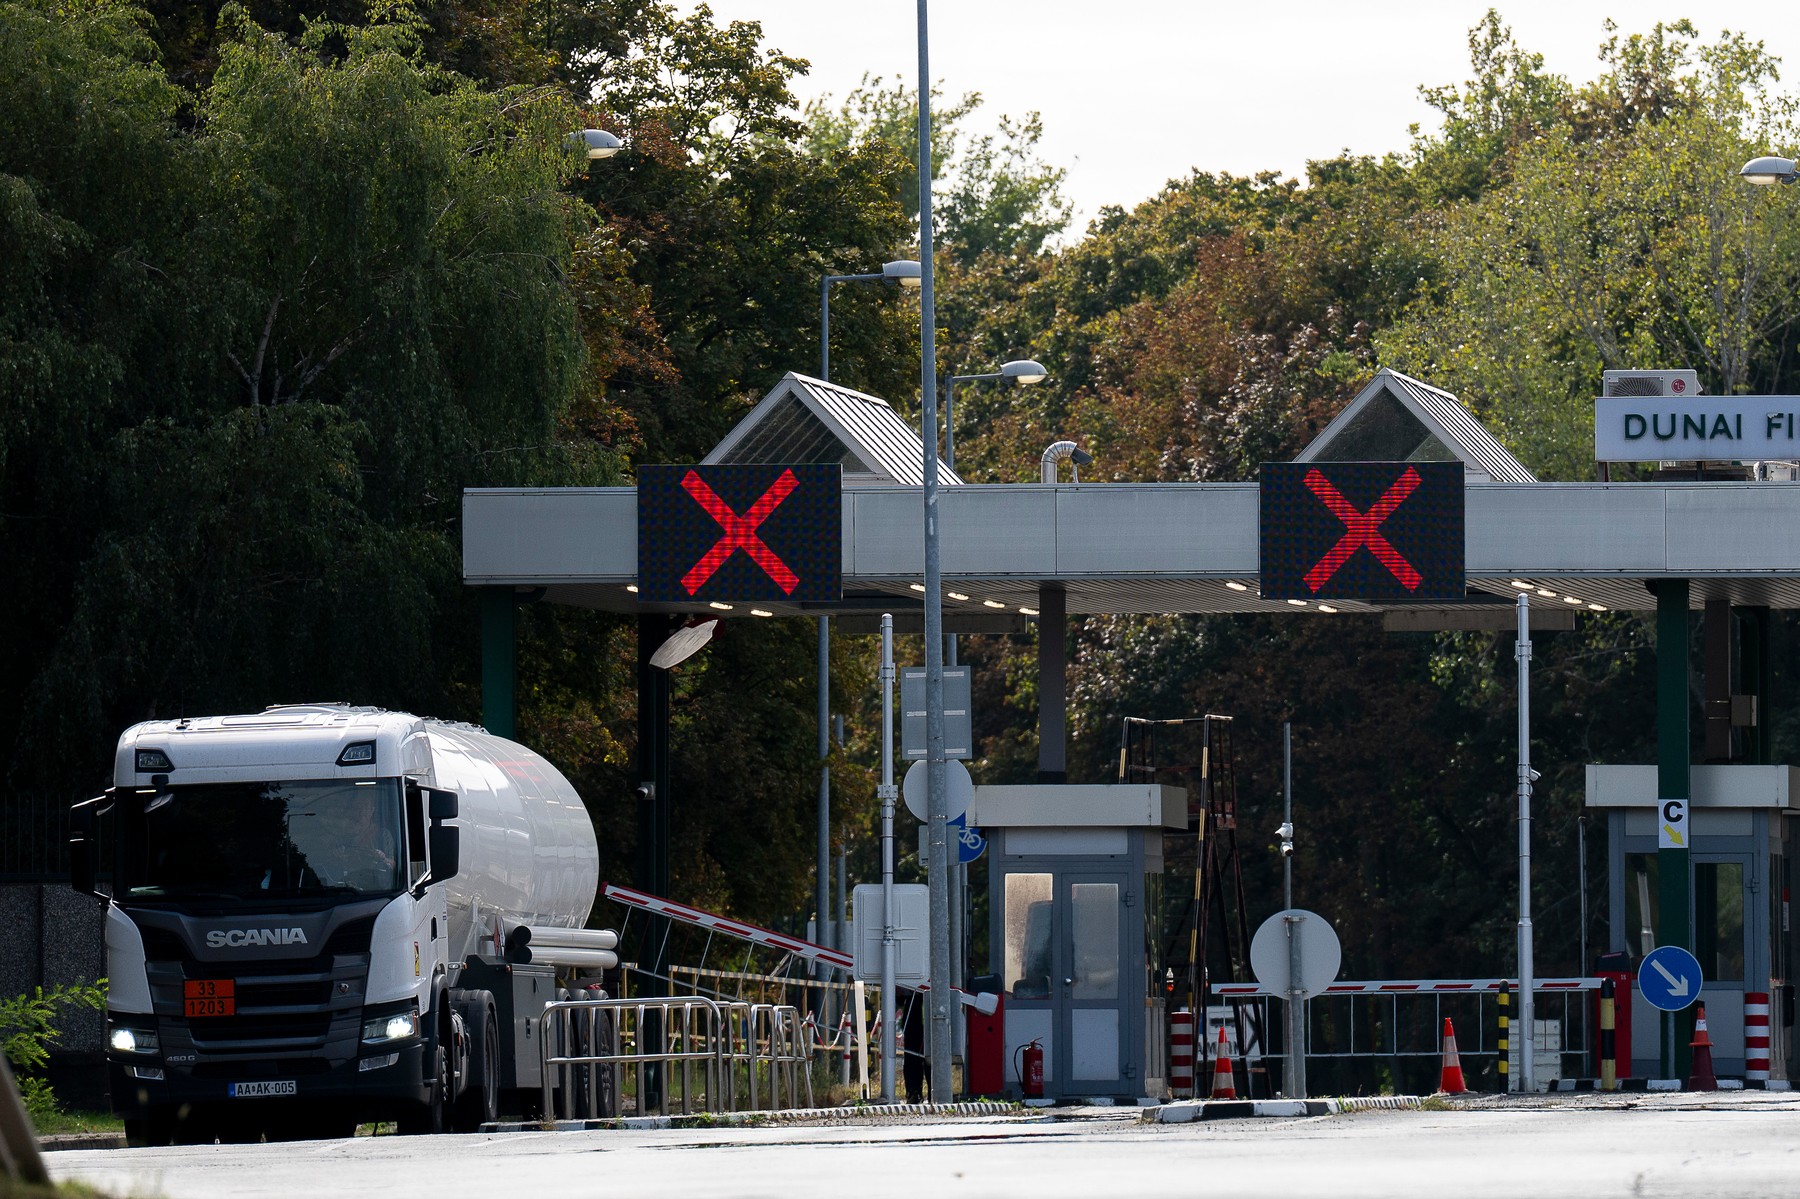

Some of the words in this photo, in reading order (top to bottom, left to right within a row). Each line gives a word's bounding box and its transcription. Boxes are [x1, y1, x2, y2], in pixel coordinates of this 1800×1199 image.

[1624, 413, 1742, 440] DUNAI
[1766, 413, 1800, 440] FI
[1663, 801, 1684, 823] C
[206, 927, 308, 948] SCANIA
[198, 982, 215, 996] 33
[190, 1000, 225, 1015] 1203
